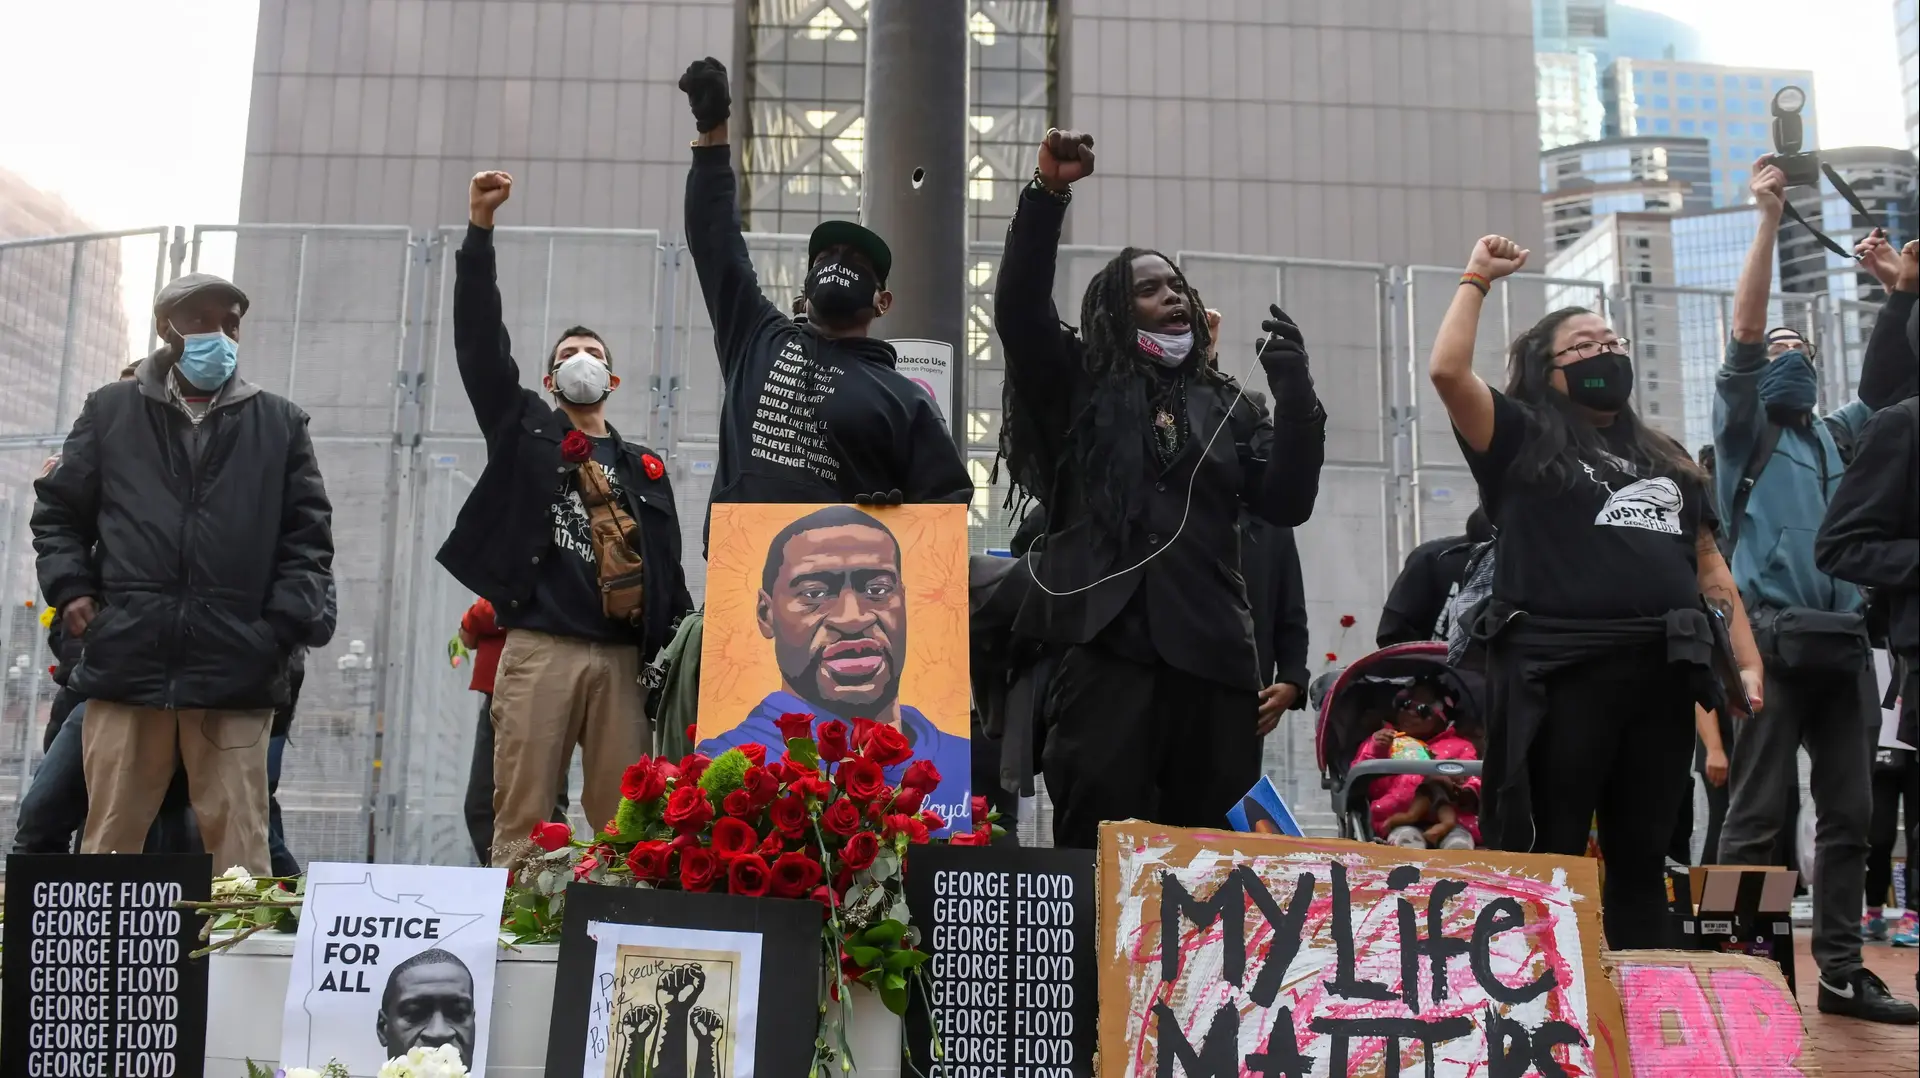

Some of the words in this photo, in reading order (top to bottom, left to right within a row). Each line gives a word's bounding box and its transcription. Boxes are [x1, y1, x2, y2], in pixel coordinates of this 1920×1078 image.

[818, 274, 851, 288] MATTER
[839, 265, 860, 281] LIVES
[773, 360, 803, 375] FIGHT
[780, 349, 803, 364] LEAD
[896, 355, 930, 365] obacco
[931, 357, 947, 367] Use
[768, 370, 798, 387] THINK
[920, 366, 944, 375] Property
[763, 382, 796, 400] WRITE
[759, 395, 789, 410] BUILD
[790, 405, 803, 416] LIKE
[756, 408, 789, 424] SPEAK
[789, 418, 804, 430] LIKE
[752, 420, 797, 439] EDUCATE
[797, 434, 811, 447] LIKE
[791, 444, 806, 455] LIKE
[806, 451, 841, 469] THURGOOD
[820, 468, 837, 481] ROSA
[1605, 506, 1667, 523] JUSTICE
[553, 526, 575, 551] ATE
[919, 792, 970, 829] loyd
[33, 882, 114, 908] GEORGE
[120, 882, 182, 908] FLOYD
[935, 870, 1010, 898] GEORGE
[1016, 873, 1074, 899] FLOYD
[32, 910, 112, 936] GEORGE
[118, 910, 181, 936] FLOYD
[934, 898, 1010, 925] GEORGE
[1016, 900, 1074, 926] FLOYD
[327, 915, 441, 940] JUSTICE
[932, 925, 1009, 952] GEORGE
[1016, 927, 1074, 953] FLOYD
[1159, 863, 1316, 1008] MY
[1322, 859, 1560, 1015] Life
[31, 939, 111, 965] GEORGE
[117, 939, 180, 965] FLOYD
[323, 942, 380, 965] FOR
[30, 967, 110, 993] GEORGE
[117, 967, 179, 993] FLOYD
[599, 960, 665, 997] Prosecute
[932, 953, 1009, 980] GEORGE
[1015, 955, 1074, 981] FLOYD
[319, 970, 371, 993] ALL
[931, 980, 1008, 1007] GEORGE
[1015, 982, 1074, 1009] FLOYD
[30, 995, 110, 1021] GEORGE
[117, 995, 179, 1021] FLOYD
[593, 992, 634, 1021] the
[931, 1008, 1008, 1035] GEORGE
[1014, 1010, 1074, 1037] FLOYD
[29, 1023, 109, 1049] GEORGE
[116, 1023, 178, 1049] FLOYD
[28, 1051, 108, 1078] GEORGE
[115, 1051, 176, 1078] FLOYD
[1014, 1038, 1074, 1065] FLOYD
